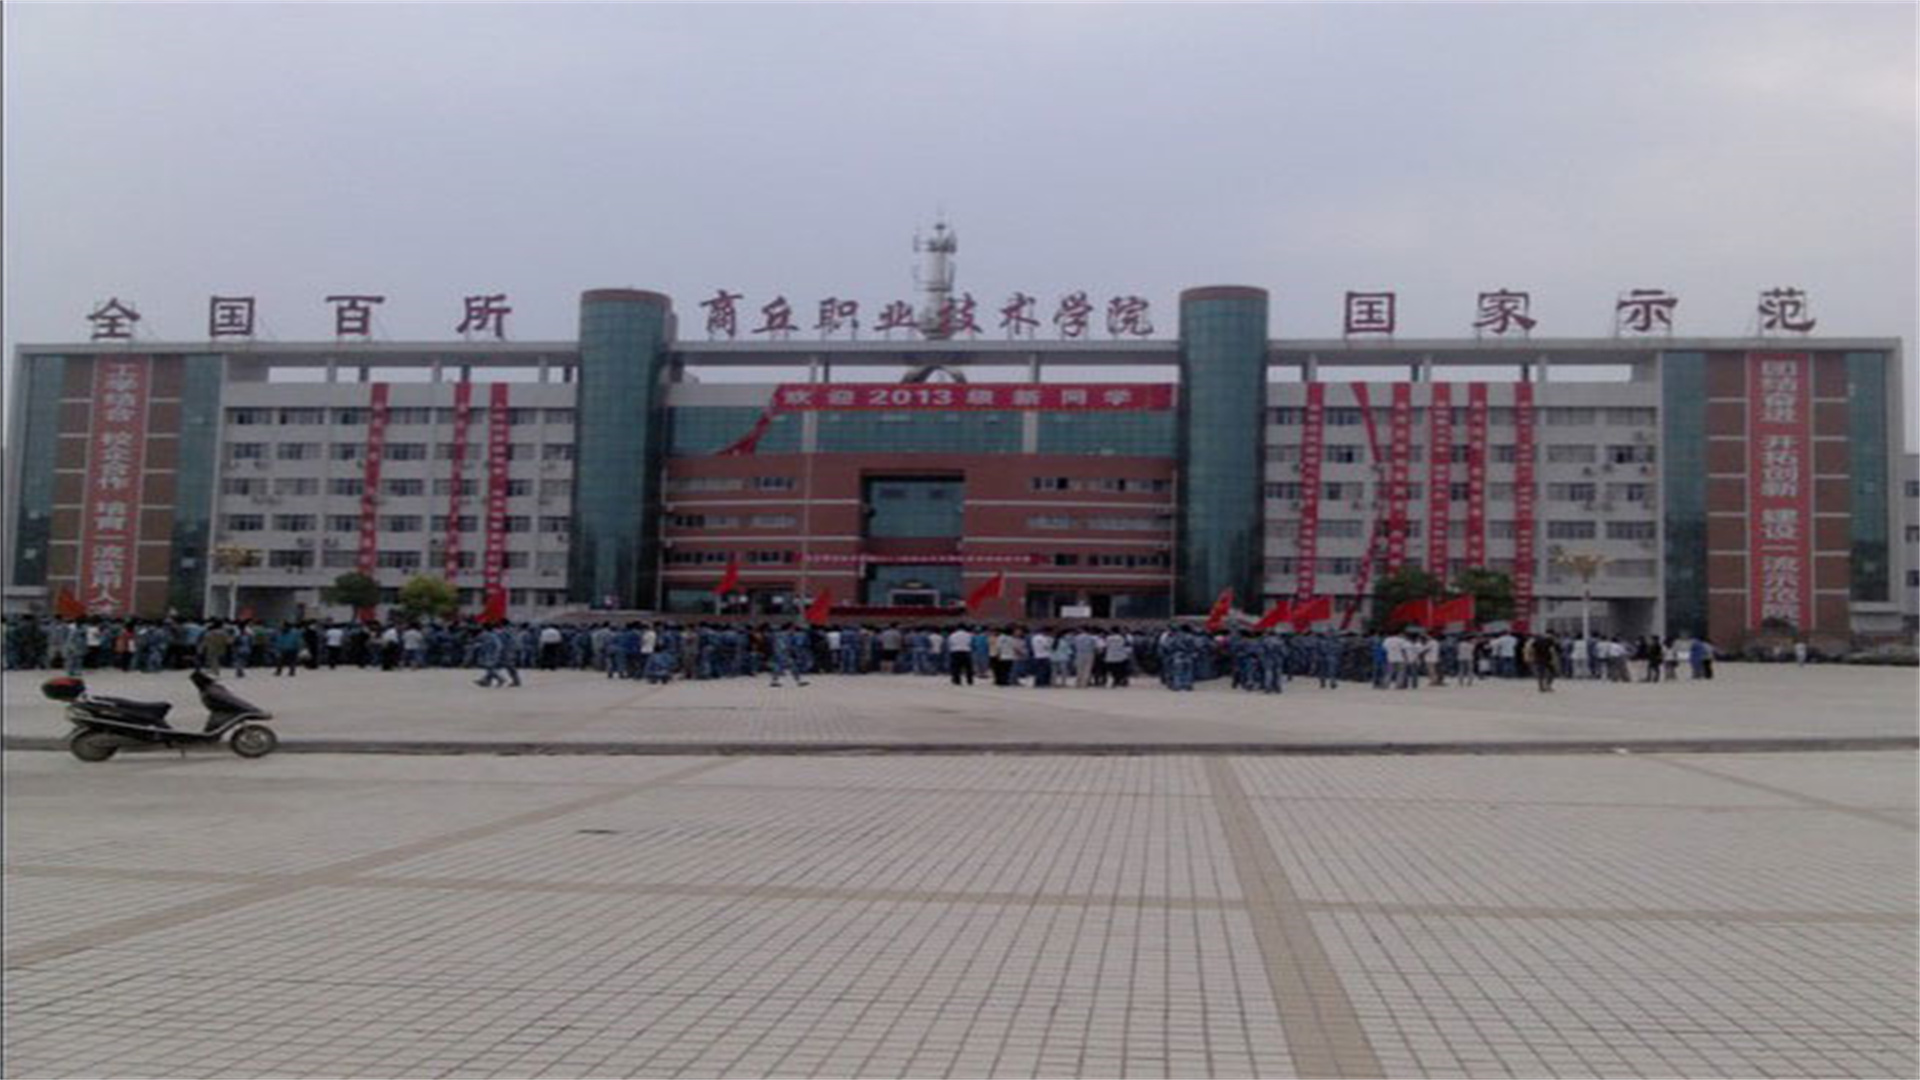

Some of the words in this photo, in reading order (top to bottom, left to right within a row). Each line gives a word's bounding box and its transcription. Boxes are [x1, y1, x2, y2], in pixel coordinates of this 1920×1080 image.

[87, 294, 511, 339] 全国百所
[701, 290, 1155, 337] 商丘职业技术学院
[1344, 286, 1816, 335] 国家示范
